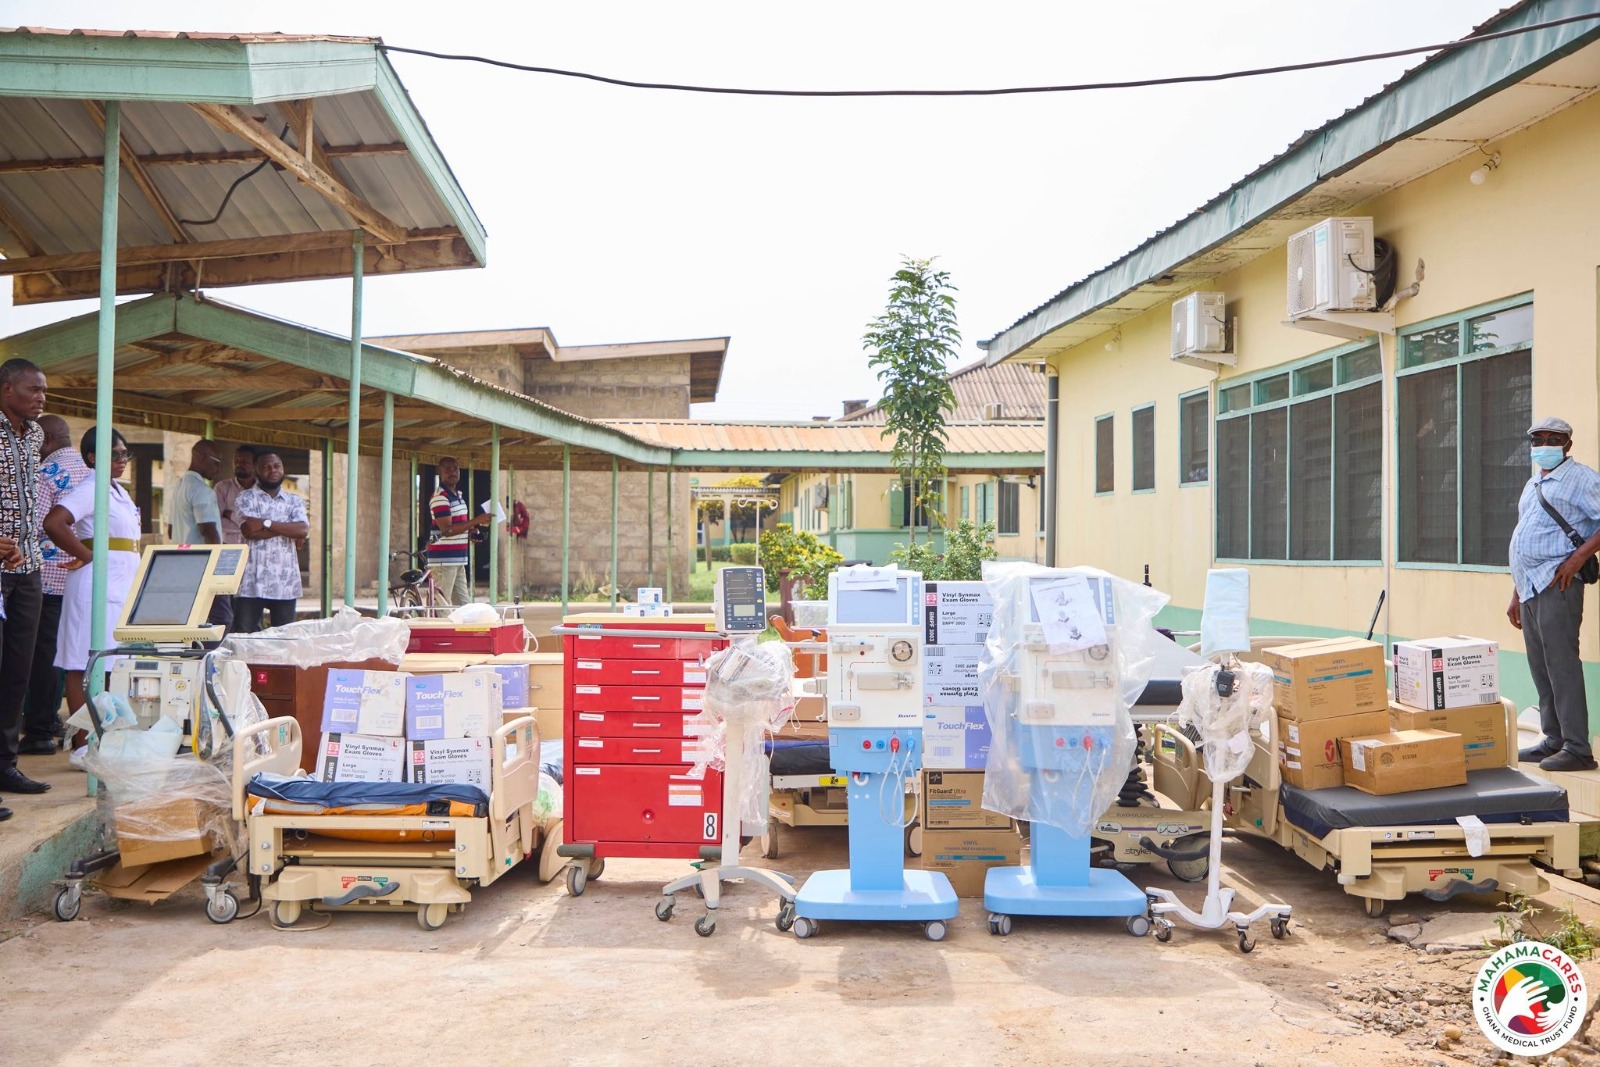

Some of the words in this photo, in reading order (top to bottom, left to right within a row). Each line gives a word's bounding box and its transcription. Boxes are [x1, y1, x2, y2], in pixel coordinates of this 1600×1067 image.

[394, 678, 401, 686] S
[335, 684, 382, 695] TouchFlex
[415, 690, 464, 700] TouchFlex
[937, 722, 984, 730] TouchFlex
[705, 814, 716, 838] 8
[1124, 847, 1152, 856] stryker
